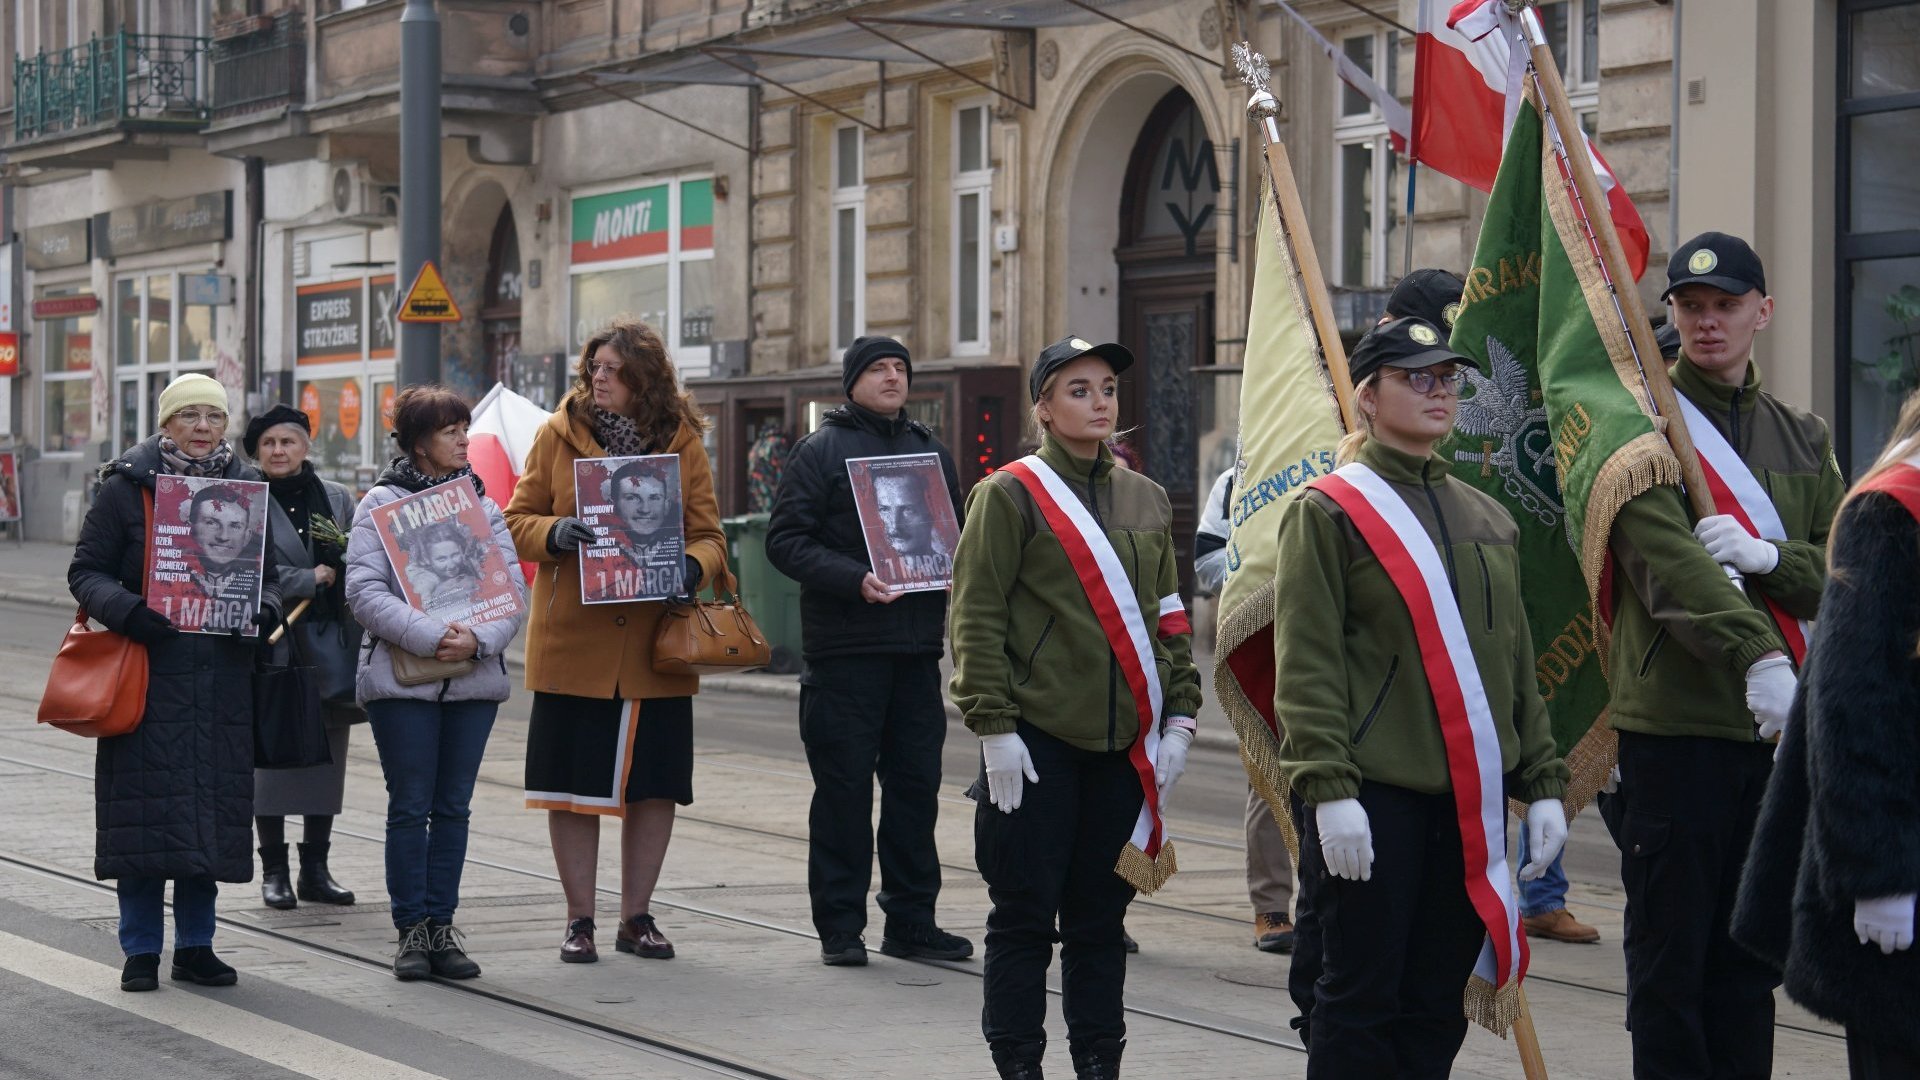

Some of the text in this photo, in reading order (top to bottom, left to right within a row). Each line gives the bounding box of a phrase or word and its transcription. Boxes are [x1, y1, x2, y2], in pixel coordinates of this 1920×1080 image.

[311, 298, 352, 322] EXPRESS
[303, 323, 358, 349] STRZYŻENIE
[387, 485, 473, 534] 1 MARCA
[583, 504, 615, 514] NARODOWY
[158, 524, 191, 536] NARODOWY
[155, 535, 173, 546] DZIEŃ
[157, 548, 182, 559] PAMIĘCI
[586, 548, 620, 558] WYKLĘTYCH
[156, 559, 188, 571] ŻOŁNIERZY
[884, 557, 897, 580] 1
[155, 572, 191, 583] WYKLĘTYCH
[596, 566, 684, 598] 1 MARCA
[162, 596, 254, 630] 1 MARCA
